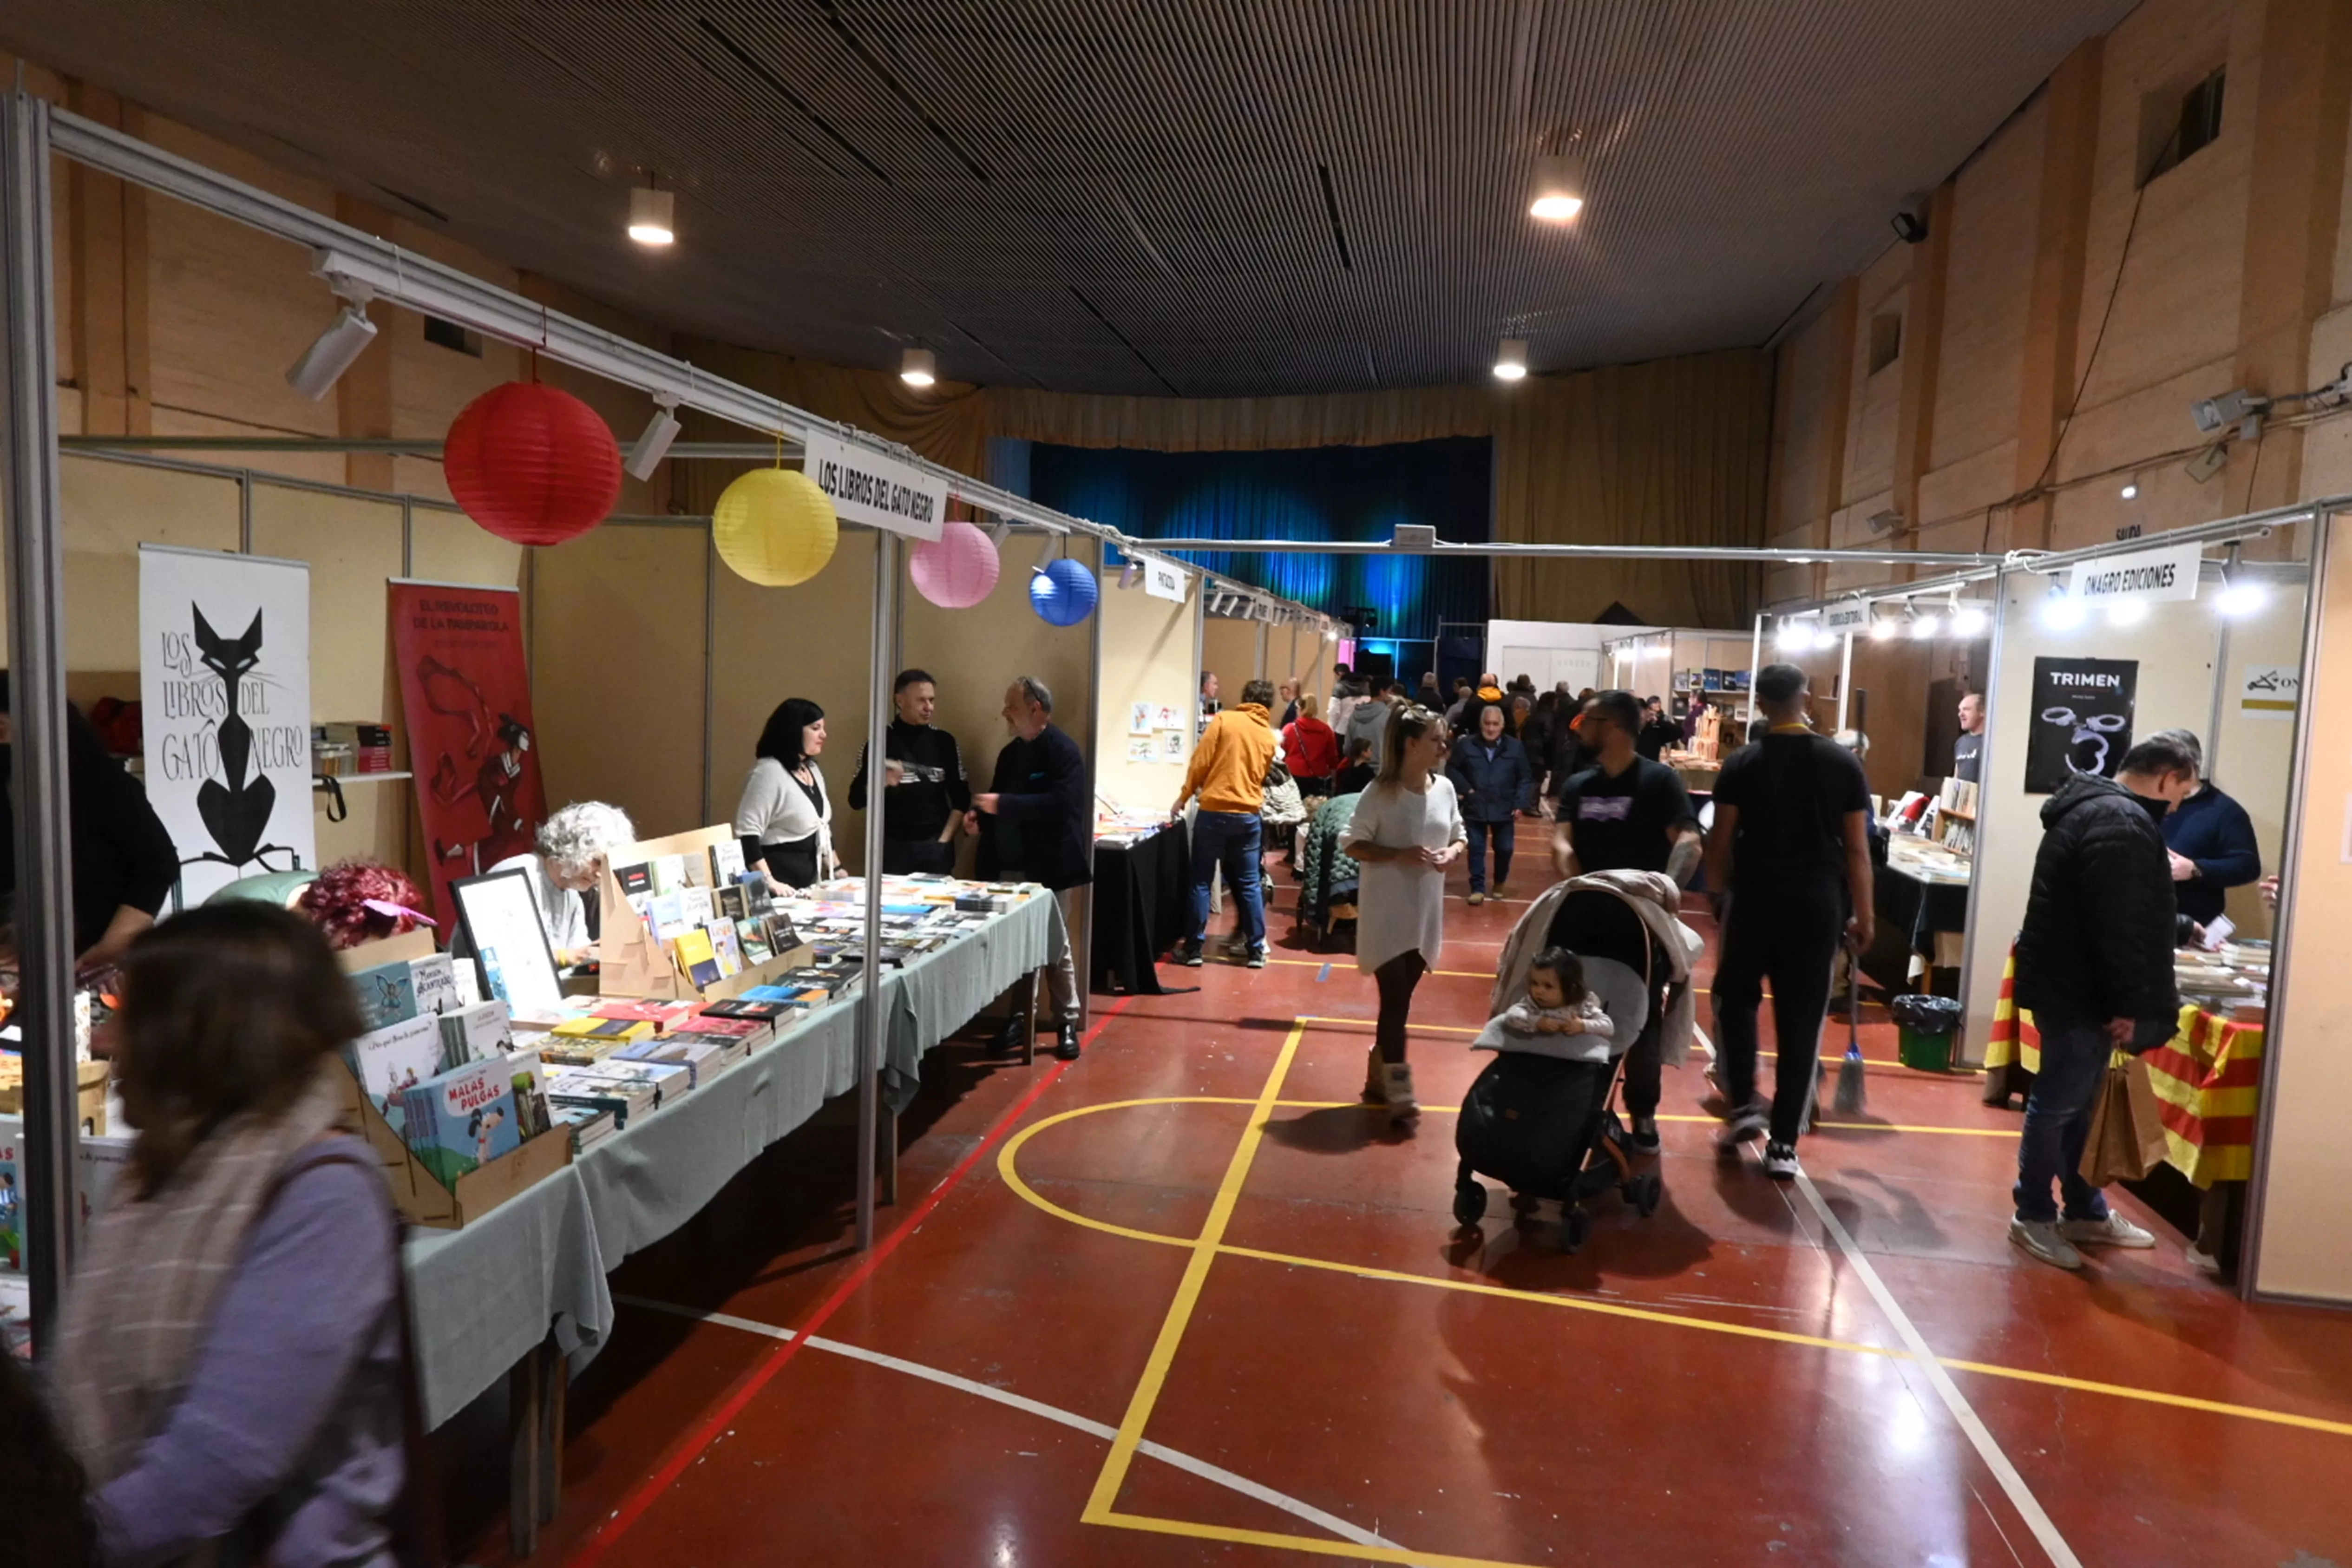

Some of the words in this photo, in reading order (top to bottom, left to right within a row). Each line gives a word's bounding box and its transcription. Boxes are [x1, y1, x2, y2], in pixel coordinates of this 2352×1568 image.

[819, 458, 838, 496] LOS
[839, 465, 873, 506] LIBROS
[873, 477, 889, 511] DEL
[891, 483, 911, 517] GATO
[910, 490, 934, 524] NEGRO
[2084, 571, 2121, 596] ONAGRO
[2122, 563, 2175, 591] EDICIONES
[162, 631, 192, 679] LOS
[2050, 671, 2120, 687] TRIMEN
[164, 681, 226, 719] LIBROS
[241, 682, 270, 715] DEL
[163, 725, 220, 781] GATO
[249, 726, 302, 774] NEGRO
[448, 1077, 484, 1102] MALAS
[461, 1085, 500, 1111] PULGAS
